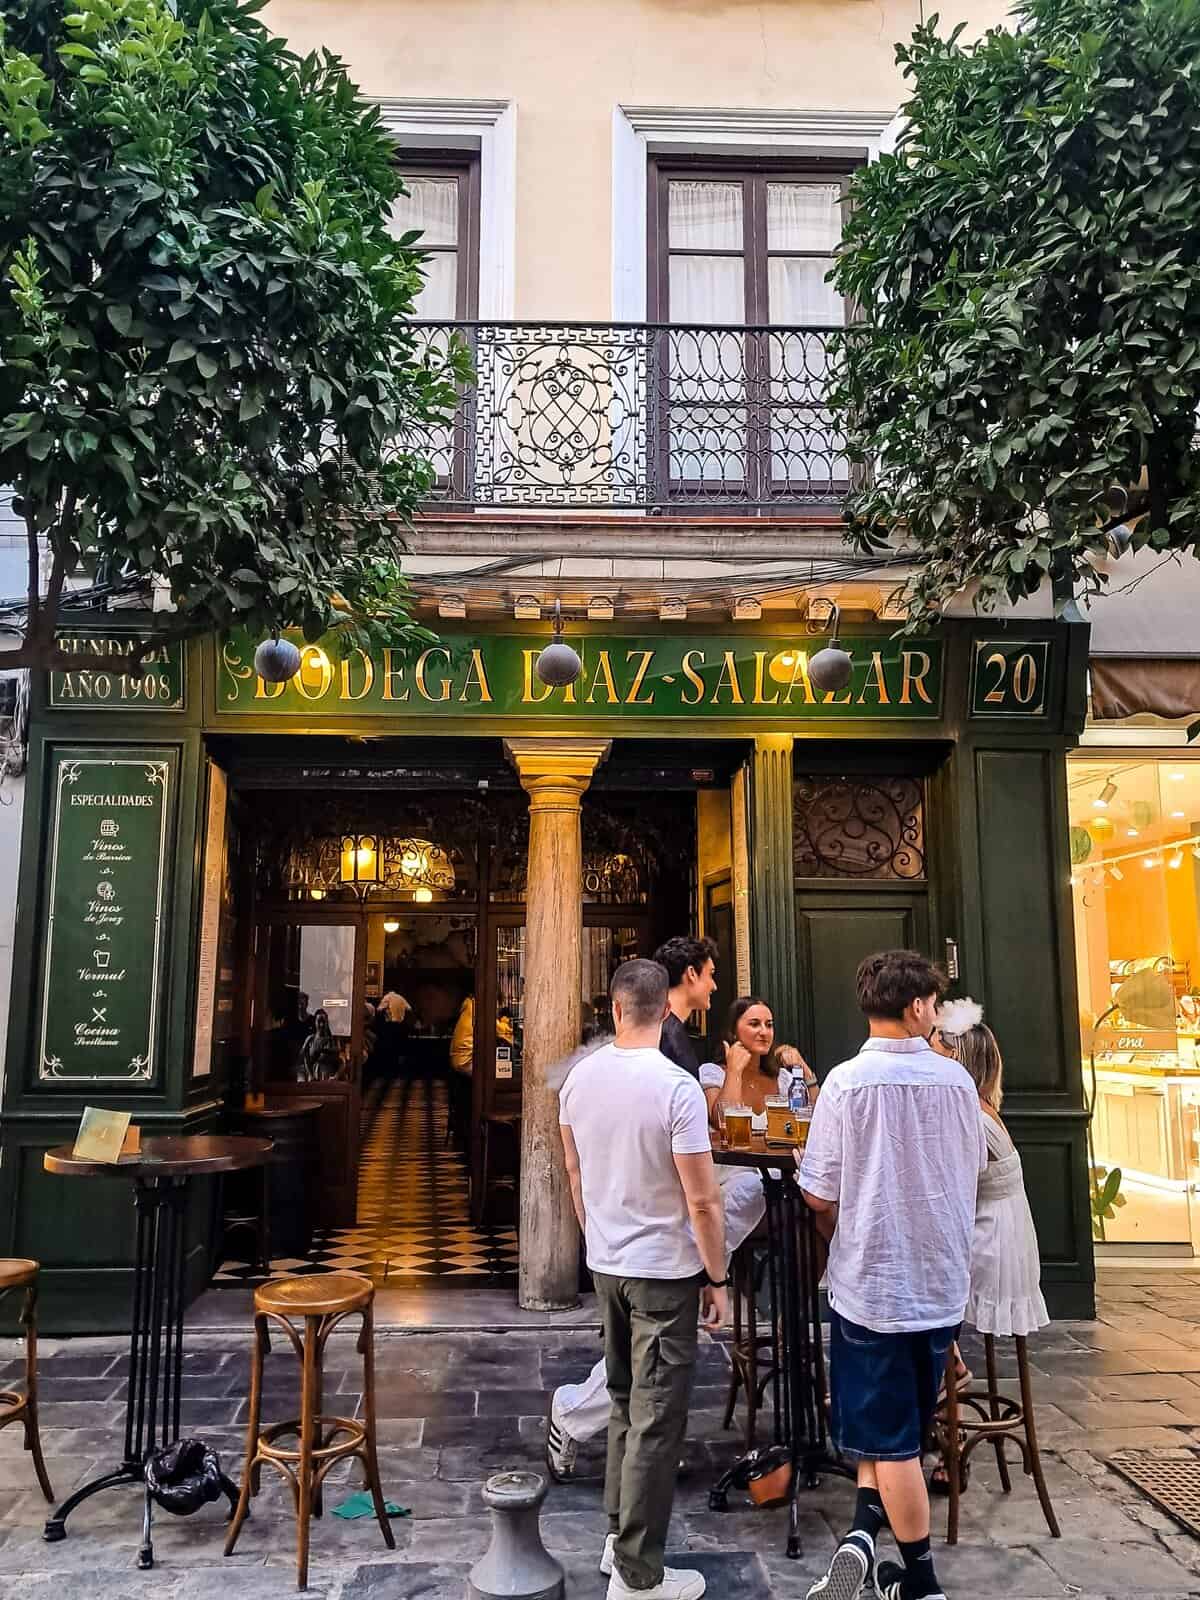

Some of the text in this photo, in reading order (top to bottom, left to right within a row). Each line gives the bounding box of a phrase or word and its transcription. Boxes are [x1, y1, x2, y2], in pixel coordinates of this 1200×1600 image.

[983, 652, 1037, 704] 20
[59, 670, 171, 700] AÑO 1908
[70, 794, 154, 807] ESPECIALIDADES
[90, 839, 127, 851] Vinos
[88, 900, 124, 913] Vinos
[74, 1023, 121, 1036] Cocina
